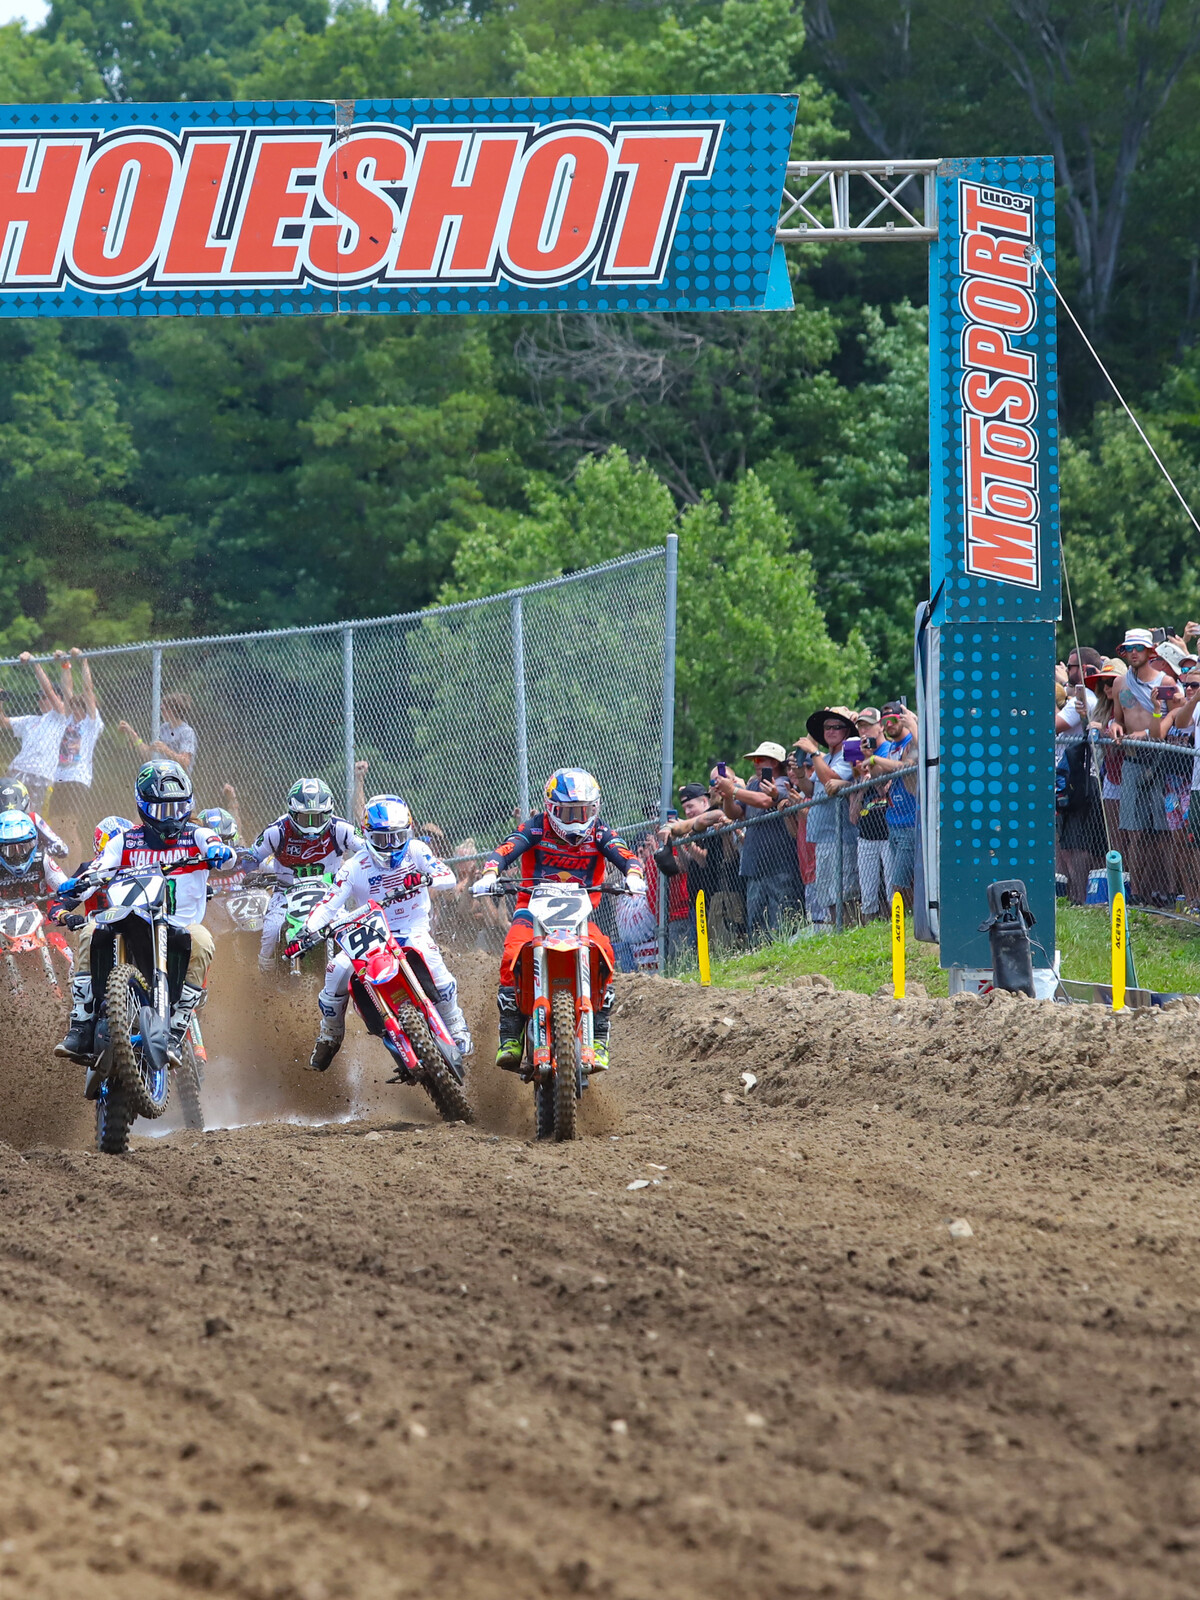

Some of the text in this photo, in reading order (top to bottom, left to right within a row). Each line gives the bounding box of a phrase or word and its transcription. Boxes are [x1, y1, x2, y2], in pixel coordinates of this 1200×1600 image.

[129, 848, 190, 867] HALLMAN
[541, 854, 591, 870] THOR
[121, 876, 153, 907] 7
[290, 890, 326, 918] 3
[230, 898, 267, 918] 29
[542, 898, 583, 927] 2
[349, 920, 387, 959] 94
[538, 1008, 546, 1046] DULOP
[389, 1030, 410, 1063] DUNLOP
